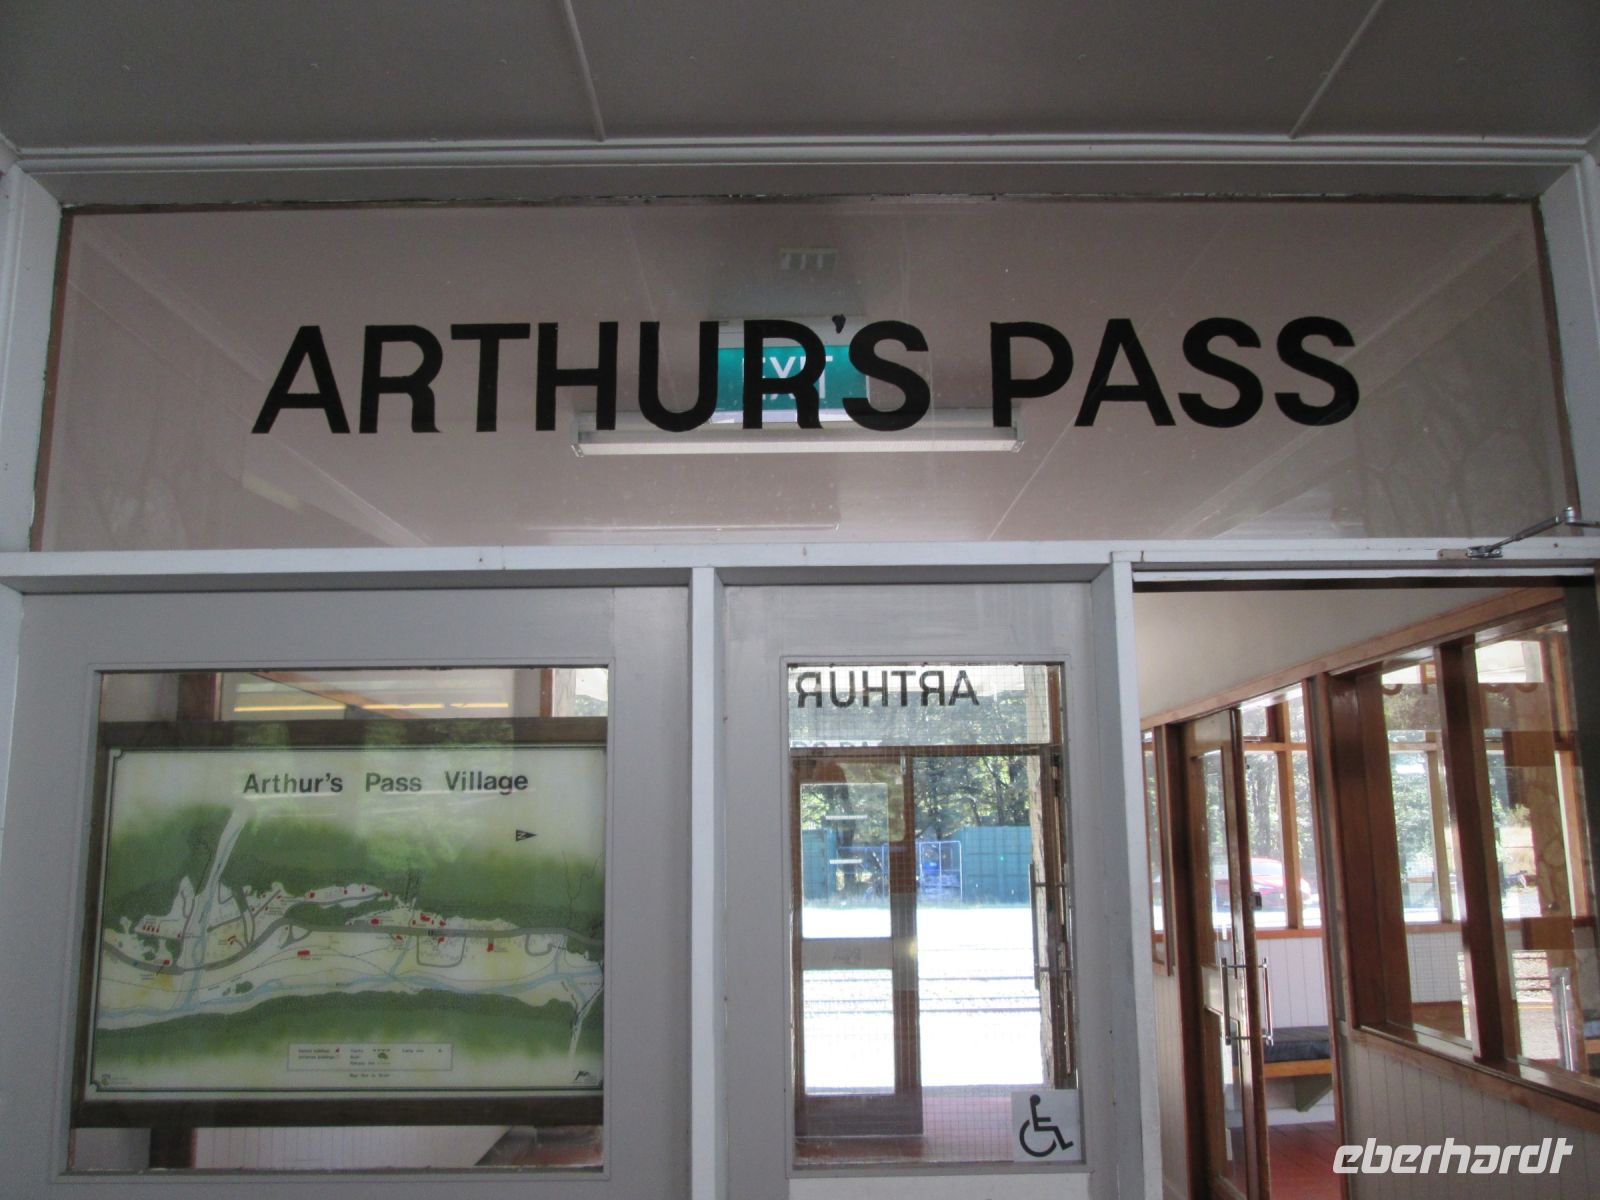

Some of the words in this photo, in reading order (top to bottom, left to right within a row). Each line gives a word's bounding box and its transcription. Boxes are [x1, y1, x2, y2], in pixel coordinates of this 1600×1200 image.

[252, 314, 931, 434] ARTHUR'S
[990, 316, 1360, 428] PASS
[243, 772, 344, 794] Arthur's
[365, 772, 423, 793] Pass
[444, 770, 529, 796] Village
